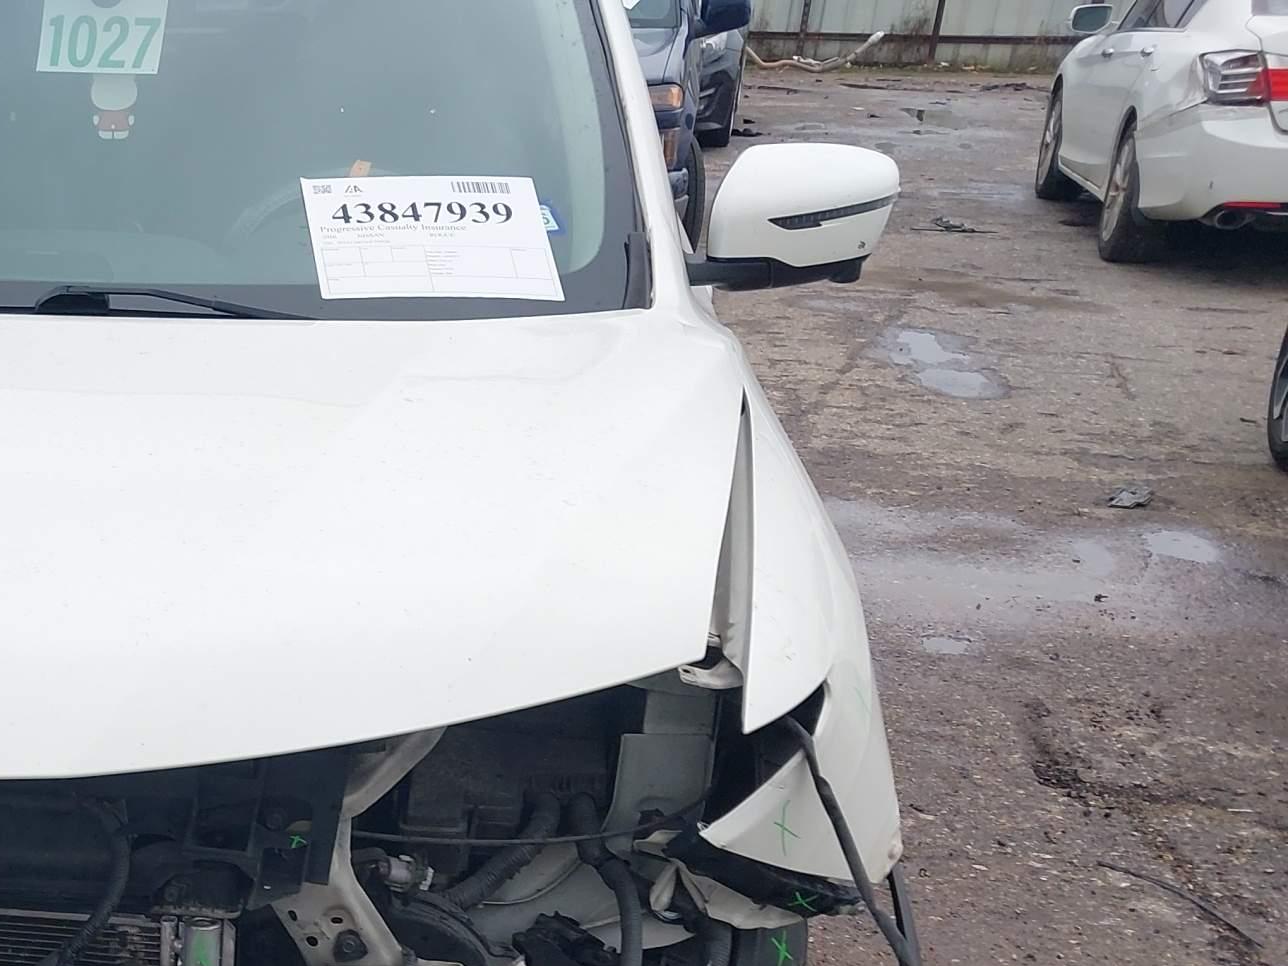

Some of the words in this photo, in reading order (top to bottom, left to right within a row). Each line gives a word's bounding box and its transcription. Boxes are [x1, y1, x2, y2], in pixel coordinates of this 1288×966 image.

[49, 14, 162, 69] 1027
[331, 201, 513, 224] 43847939
[320, 225, 375, 233] Progressive
[377, 223, 418, 232] Casualty
[421, 223, 466, 231] Insurance
